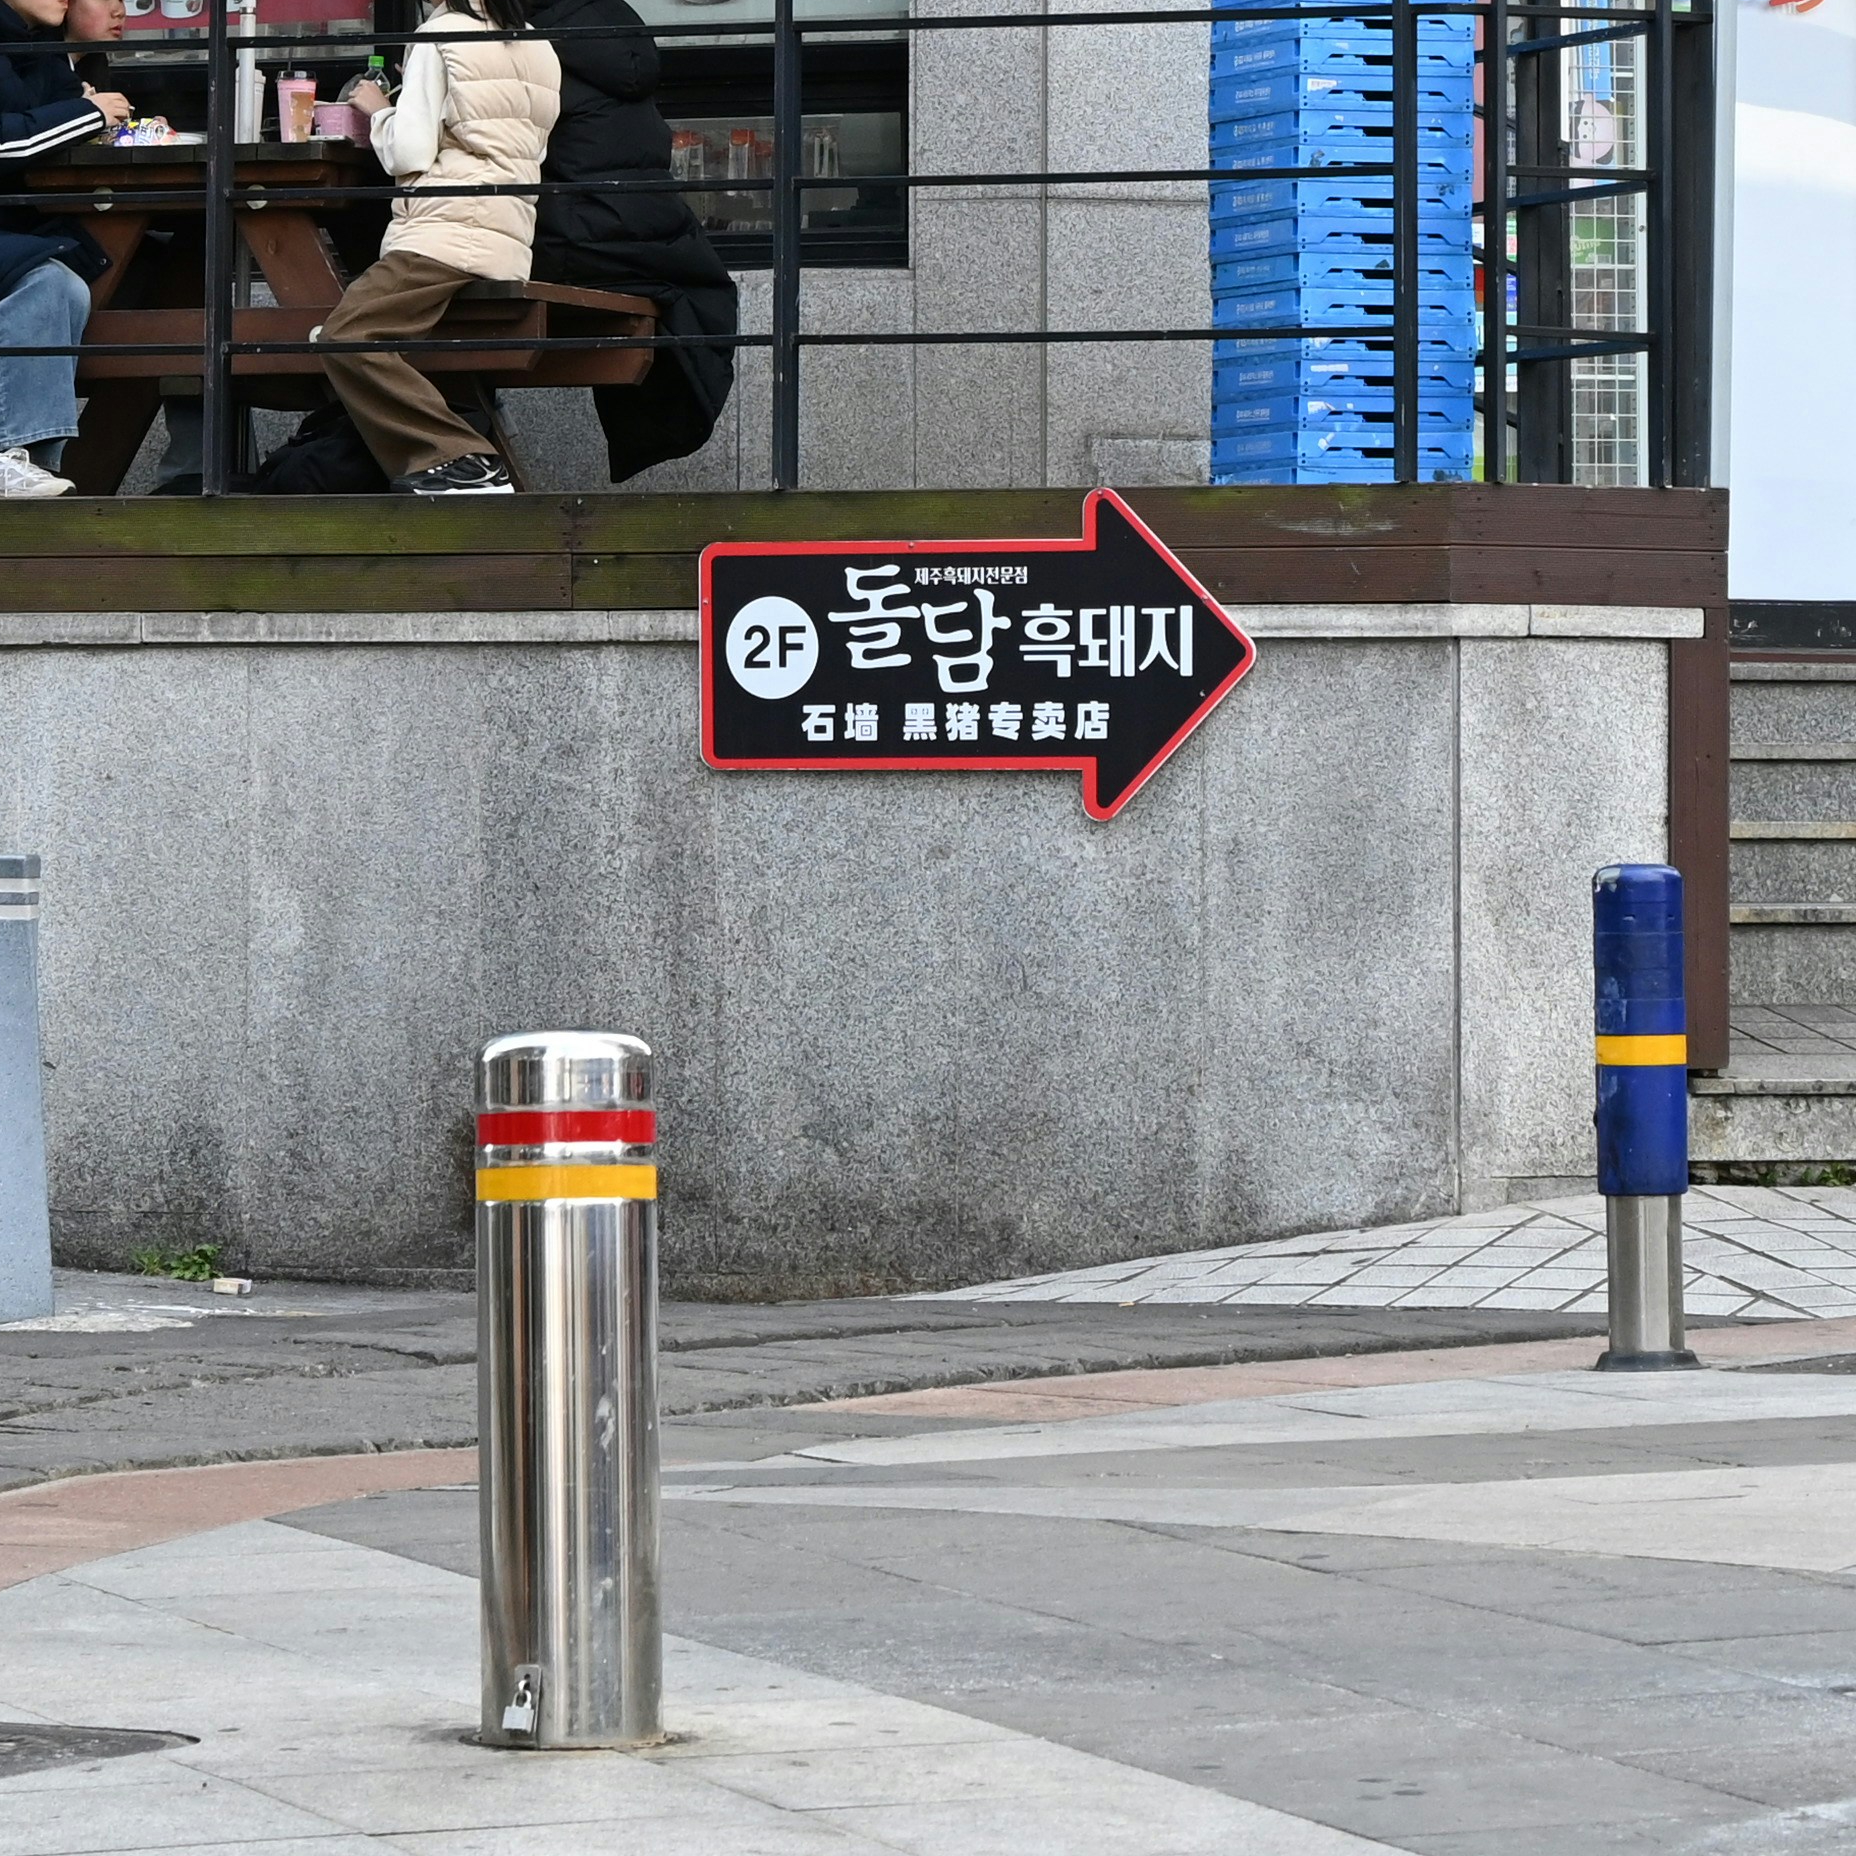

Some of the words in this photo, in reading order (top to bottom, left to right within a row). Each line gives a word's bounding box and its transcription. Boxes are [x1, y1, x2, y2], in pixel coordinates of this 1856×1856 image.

[914, 566, 1028, 586] 제주흑돼지전문점
[744, 625, 807, 669] 2F
[828, 564, 1011, 693] 돌담
[1019, 603, 1193, 677] 흑돼지
[801, 703, 879, 742] 石墙
[903, 701, 1110, 742] 黑猪专卖店
